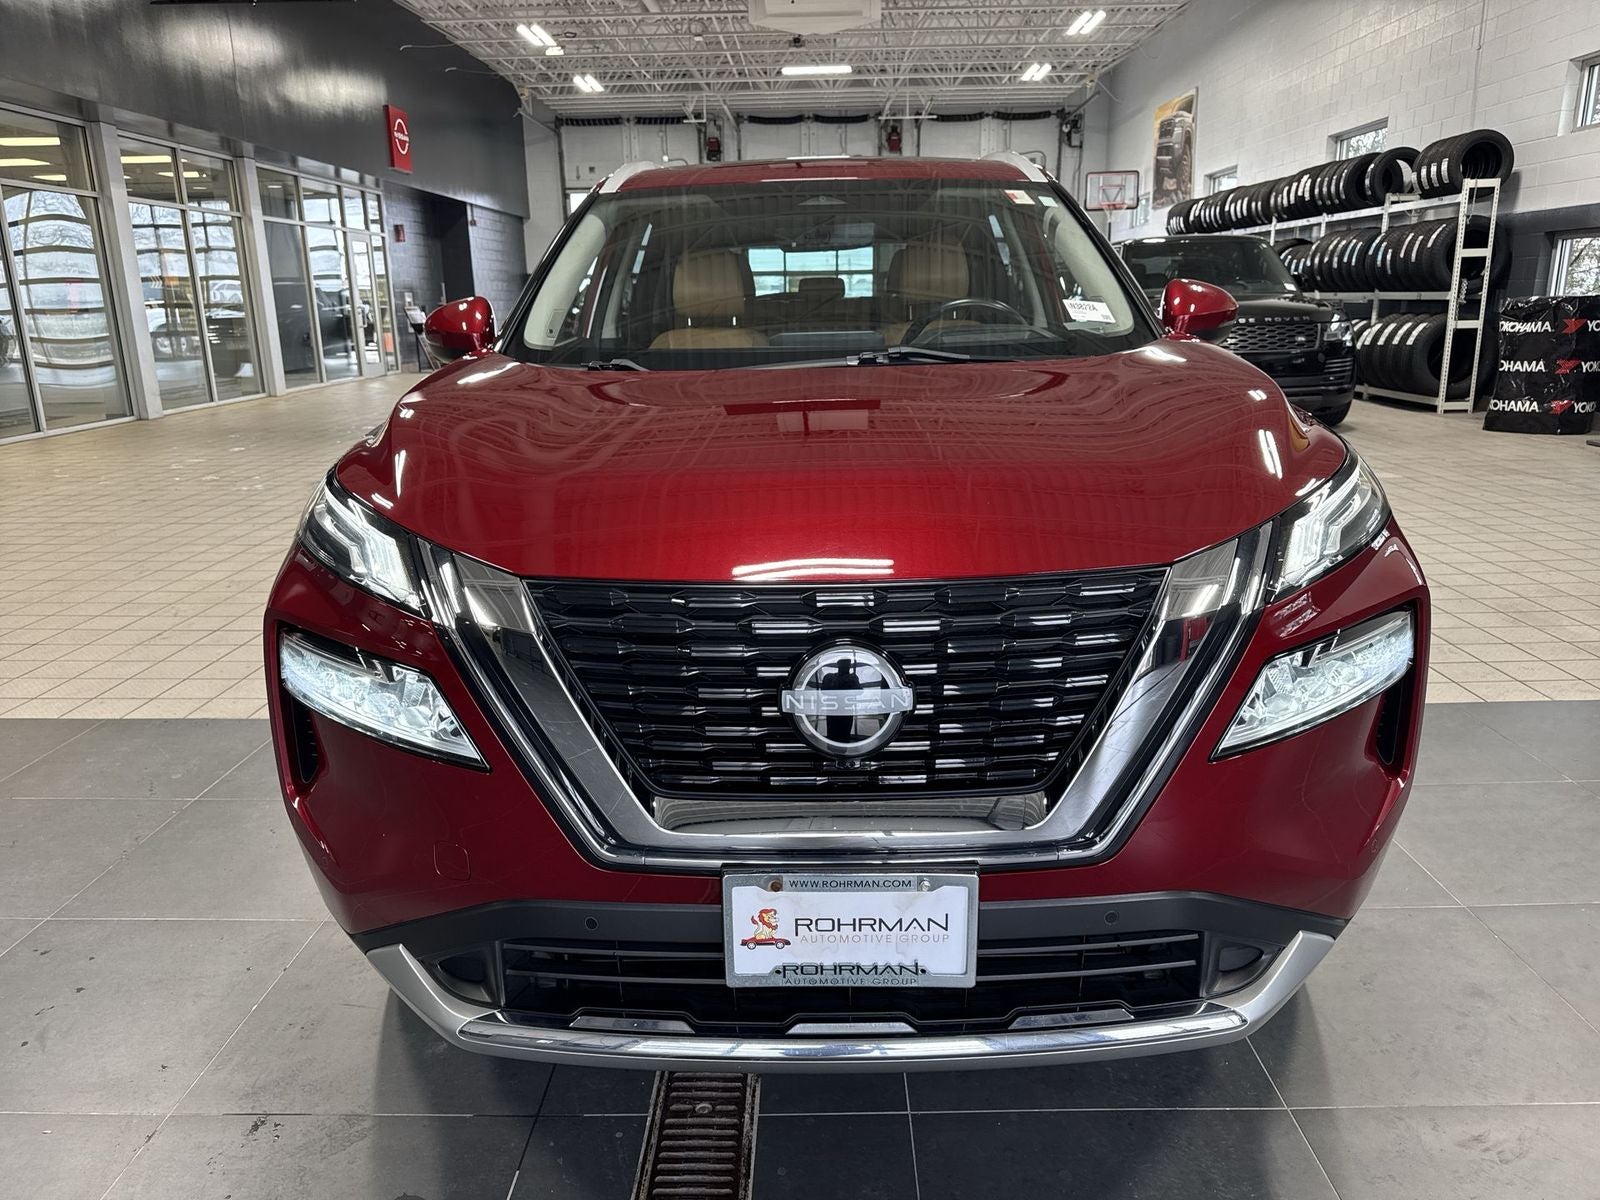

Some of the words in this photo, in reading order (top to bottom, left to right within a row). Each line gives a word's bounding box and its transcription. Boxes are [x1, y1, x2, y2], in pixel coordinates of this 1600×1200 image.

[786, 693, 909, 710] NISSAN
[788, 879, 912, 889] WWW.ROHRMAN.COM
[794, 913, 949, 937] ROHRMAN
[800, 934, 892, 944] AUTOMOTIVE
[899, 934, 950, 944] GROUP
[782, 959, 919, 979] ROHRMAN
[784, 978, 866, 986] AUTOMOTIVE
[872, 977, 918, 986] GROUP
